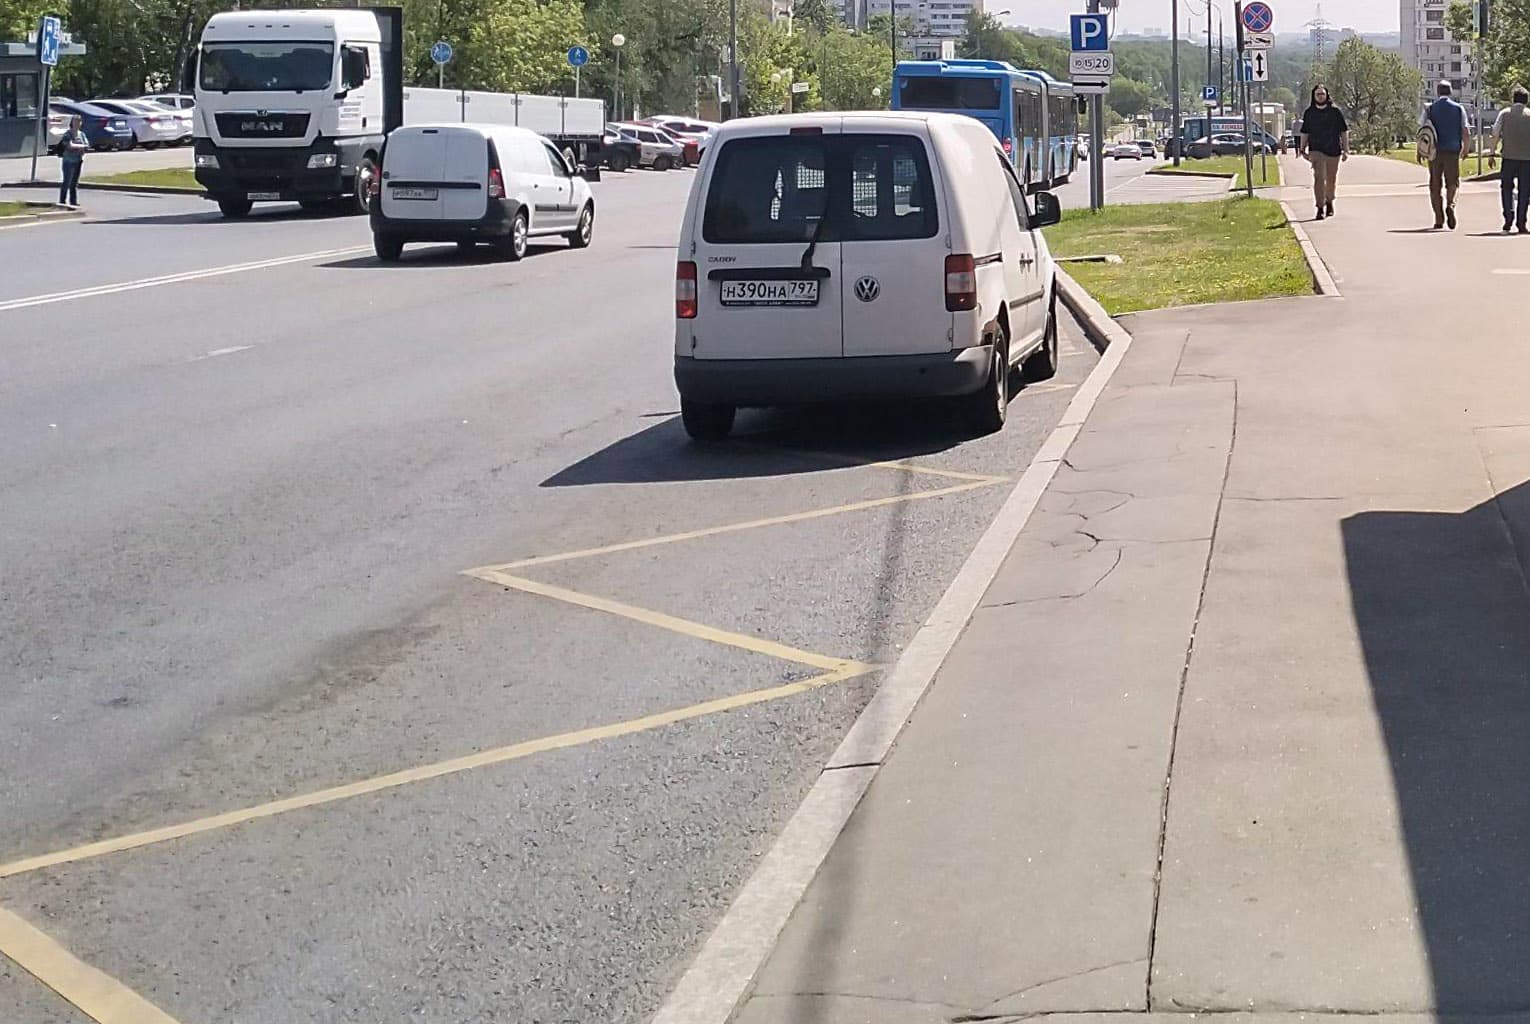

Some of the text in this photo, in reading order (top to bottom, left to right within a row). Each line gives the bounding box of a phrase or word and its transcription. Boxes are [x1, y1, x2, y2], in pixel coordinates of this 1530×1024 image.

[1080, 18, 1102, 48] P
[1085, 59, 1093, 68] 15
[1096, 58, 1109, 69] 20
[241, 121, 283, 131] MAN
[790, 282, 812, 294] 797
